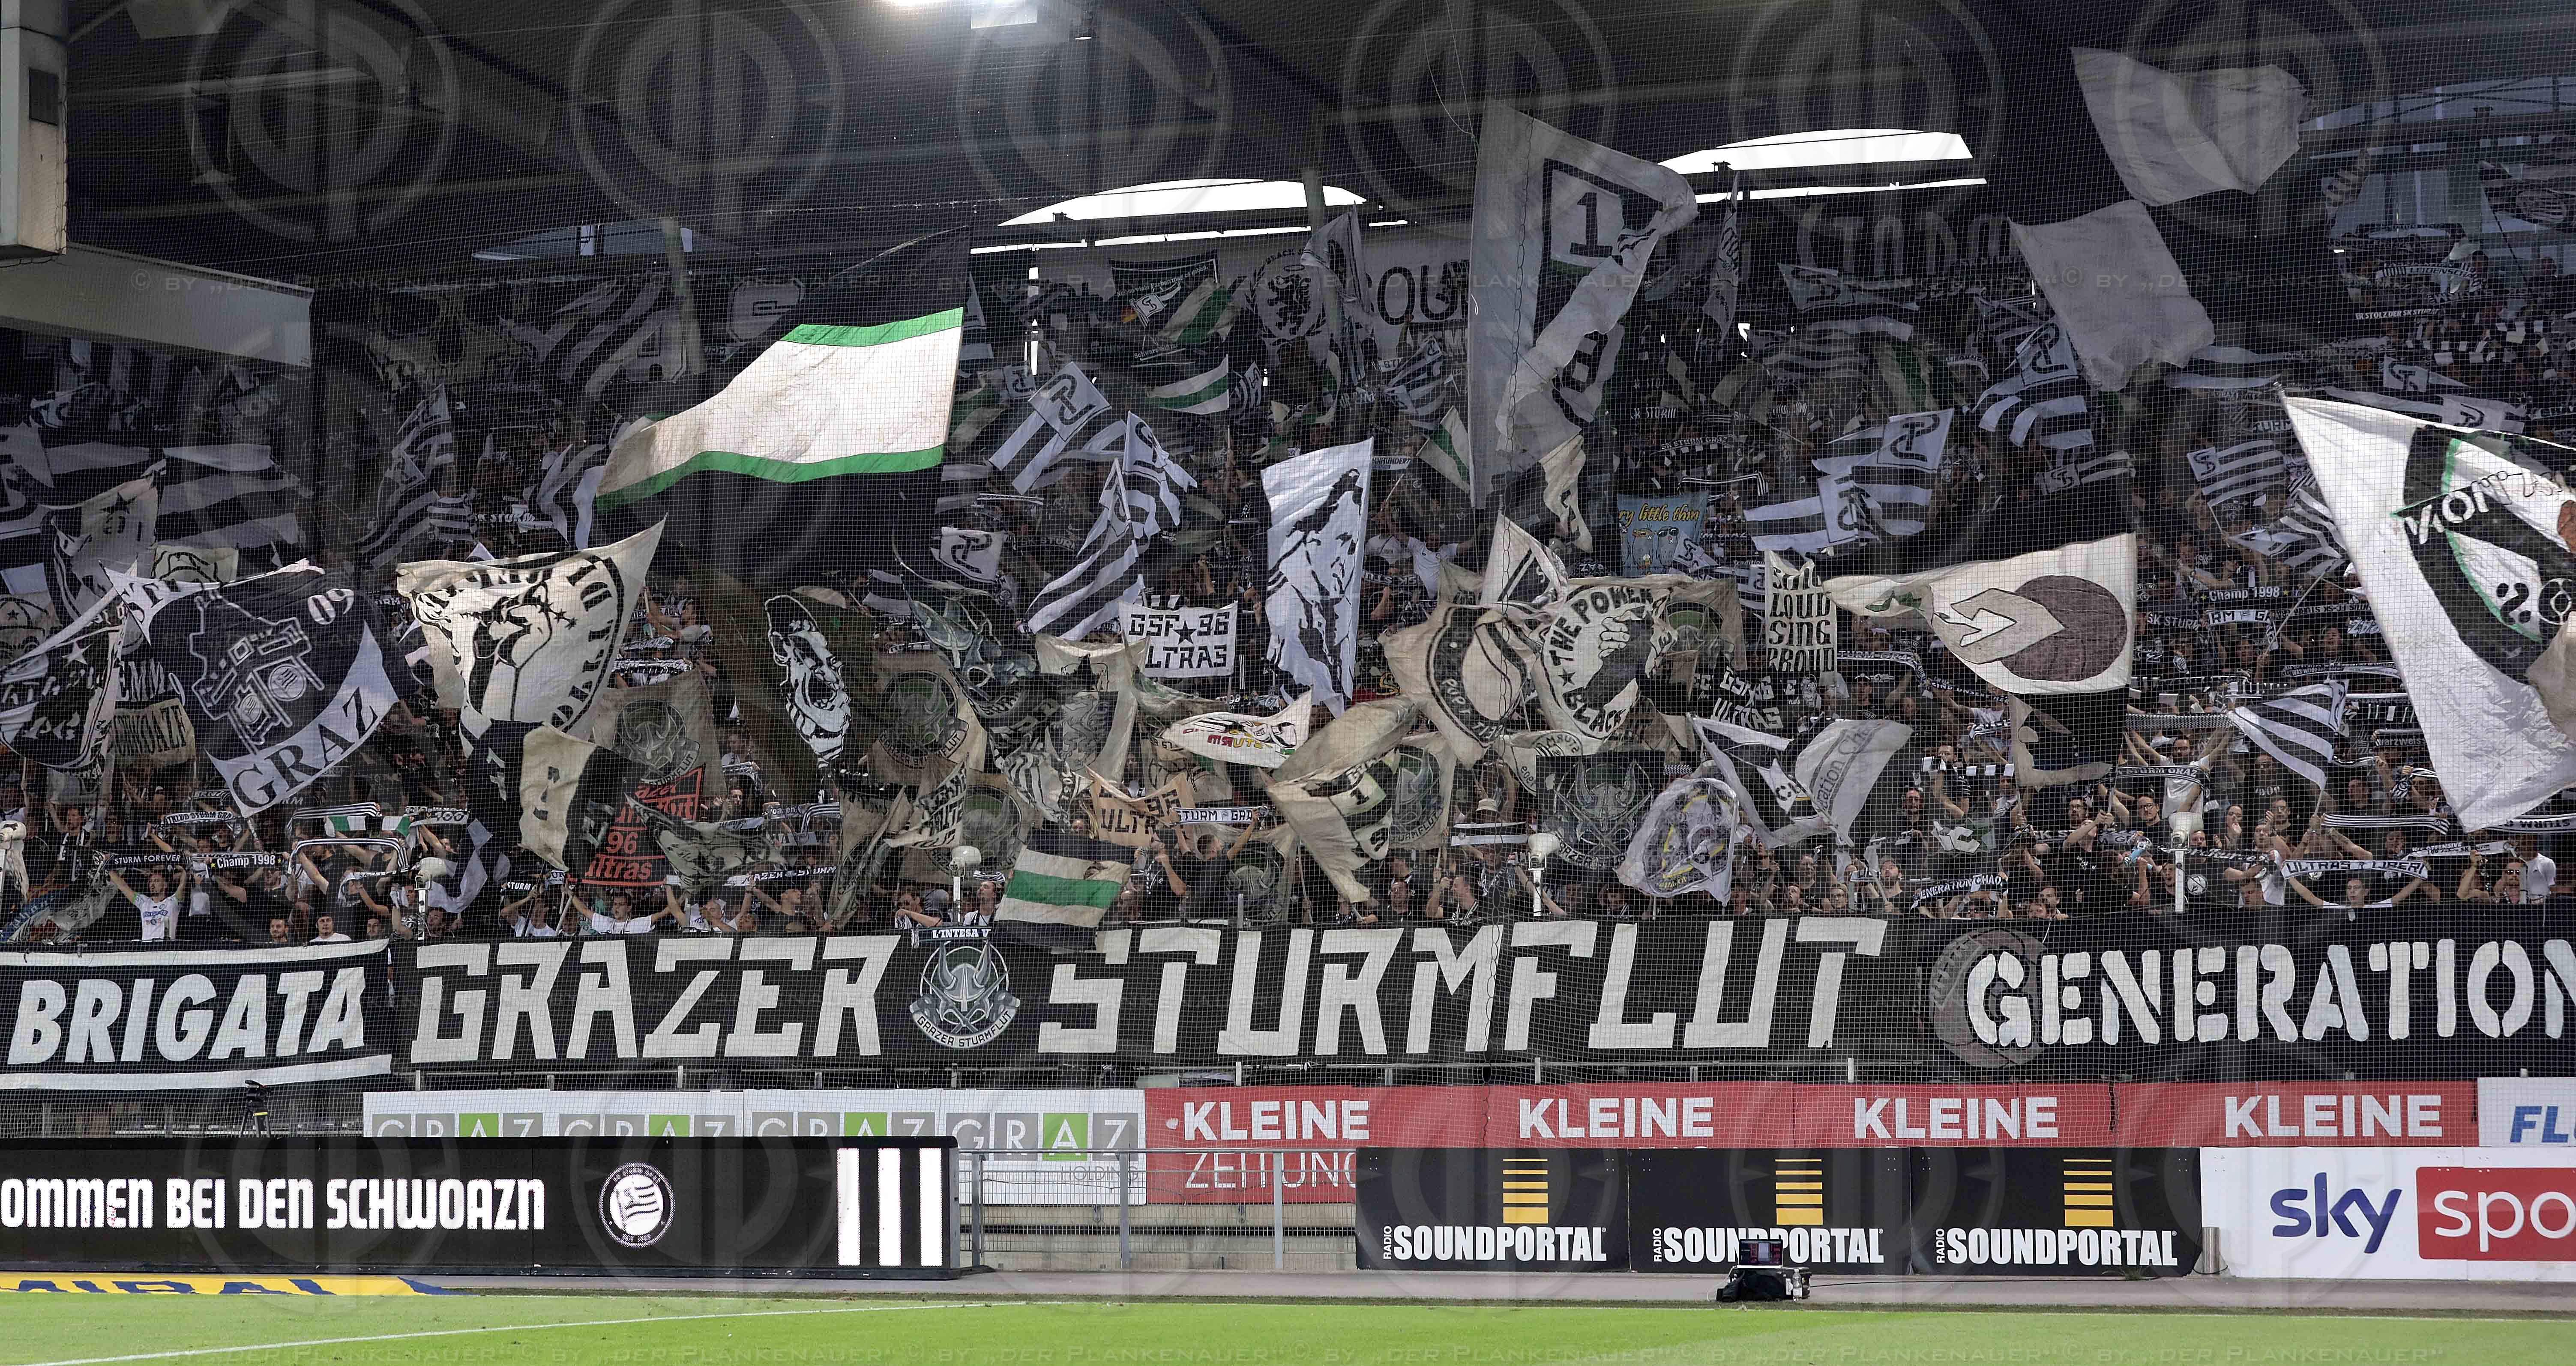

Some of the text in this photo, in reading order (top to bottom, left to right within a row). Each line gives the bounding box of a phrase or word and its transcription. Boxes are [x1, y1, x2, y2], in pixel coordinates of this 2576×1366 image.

[1638, 502, 1670, 521] little
[1770, 598, 1831, 619] LOUD
[2209, 586, 2280, 602] Champ 1998
[1129, 611, 1230, 637] GSF 96
[1769, 620, 1831, 645] SING
[2148, 613, 2162, 625] SK
[1145, 644, 1227, 669] LTRAS
[1549, 616, 1582, 667] THE
[1769, 647, 1835, 674] PROUD
[233, 688, 379, 808] GRAZ
[2168, 767, 2198, 778] GRAZ
[434, 811, 464, 821] 100
[1180, 810, 1252, 822] TURM GRA
[606, 831, 638, 855] 96
[114, 854, 181, 865] STURM FOREVER
[216, 855, 276, 870] Champ 1998
[2286, 860, 2424, 876] ULTRAS LIBERI
[507, 881, 532, 891] STURM
[932, 929, 978, 939] L'INTESA
[411, 935, 901, 1063] GRAZER
[1038, 917, 1888, 1055] STURMFLUT
[1968, 938, 2576, 1048] GENERATION
[7, 966, 365, 1065] BRIGATA
[917, 1010, 1012, 1048] GRAZER STURMFLUT
[1183, 1100, 1370, 1141] KLEINE
[1520, 1097, 1714, 1138] KLEINE
[1855, 1097, 2058, 1139] KLEINE
[2225, 1094, 2443, 1139] KLEINE
[2510, 1105, 2576, 1143] FL
[951, 1118, 1127, 1151] GRAZ
[1062, 1165, 1138, 1183] HOLDING
[1, 1178, 545, 1230] OMMEN BEI DEN SCHWOAZN
[2270, 1172, 2576, 1254] sky spo
[1383, 1226, 1392, 1261] RADIO
[1653, 1227, 1662, 1262] RADIO
[1936, 1228, 1945, 1264] RADIO
